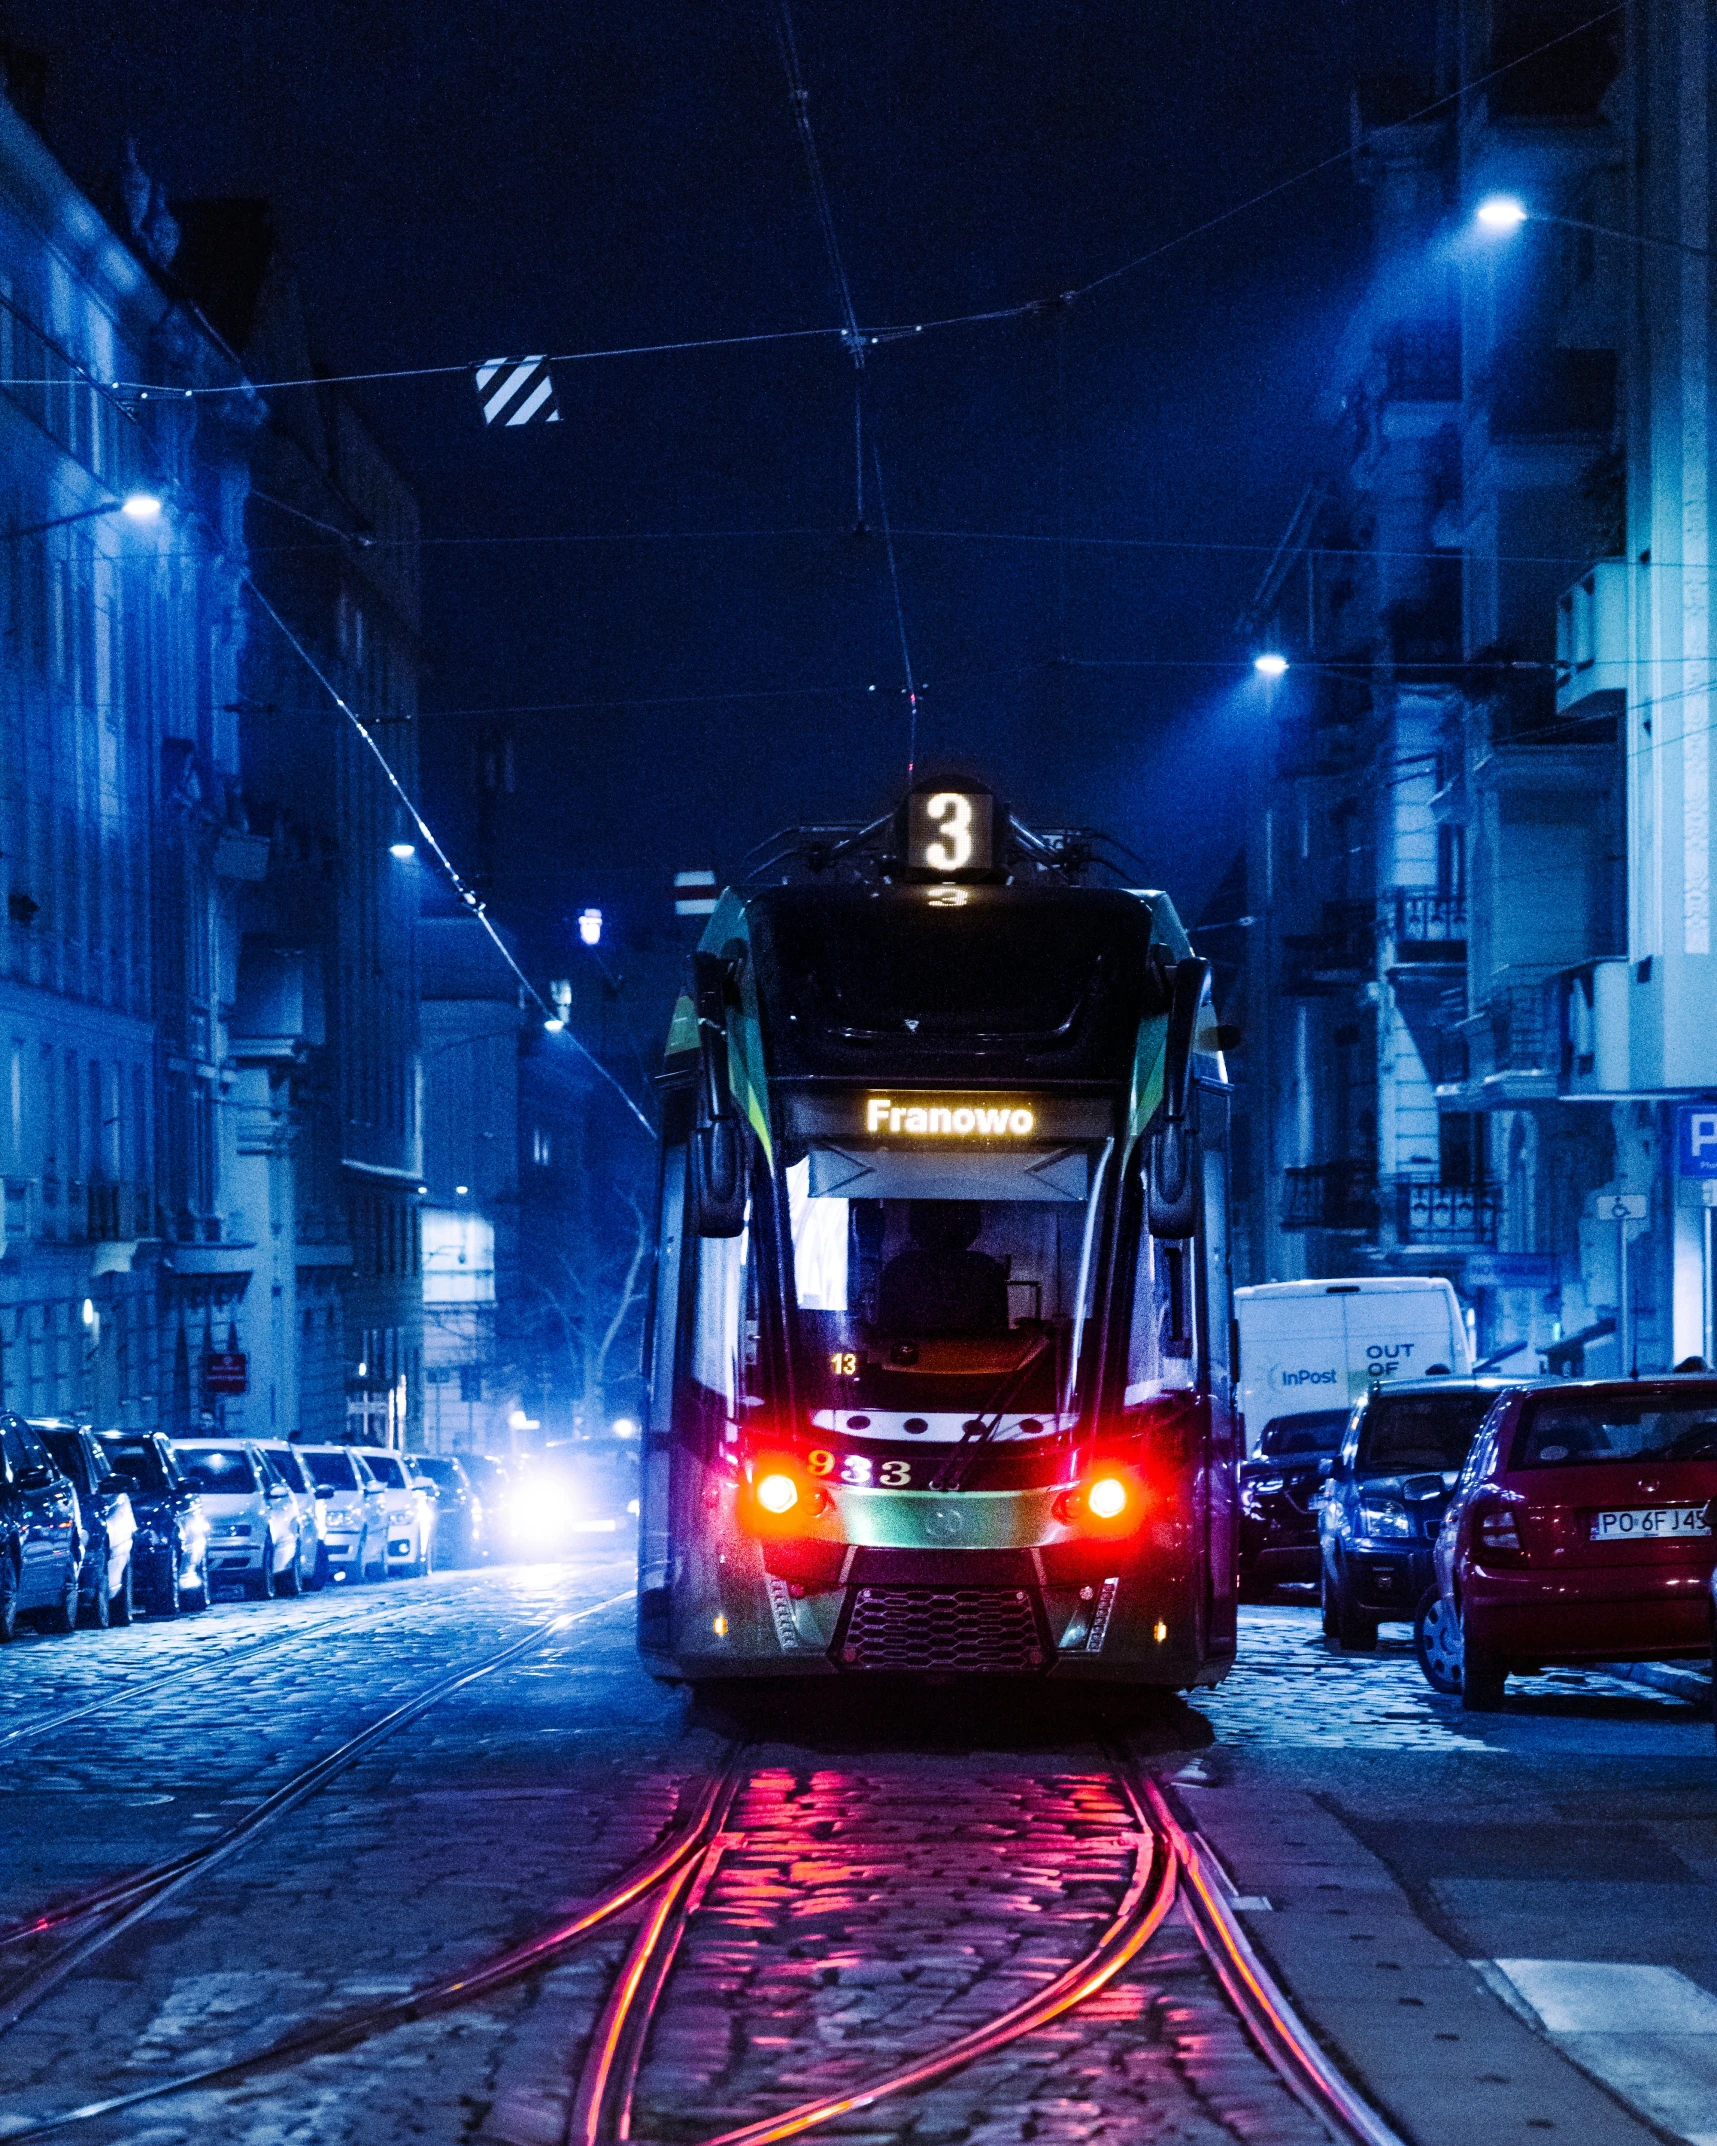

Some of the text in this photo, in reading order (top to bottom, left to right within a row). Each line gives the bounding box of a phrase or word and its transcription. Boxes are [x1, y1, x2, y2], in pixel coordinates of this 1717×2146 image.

[926, 792, 971, 871] 3
[867, 1099, 1034, 1134] Franowo
[1691, 1113, 1717, 1157] P
[1366, 1344, 1415, 1359] OUT
[831, 1353, 857, 1375] 13
[1368, 1361, 1400, 1376] OF
[1282, 1369, 1337, 1386] InPost
[806, 1449, 912, 1486] 933
[1602, 1513, 1634, 1534] PO
